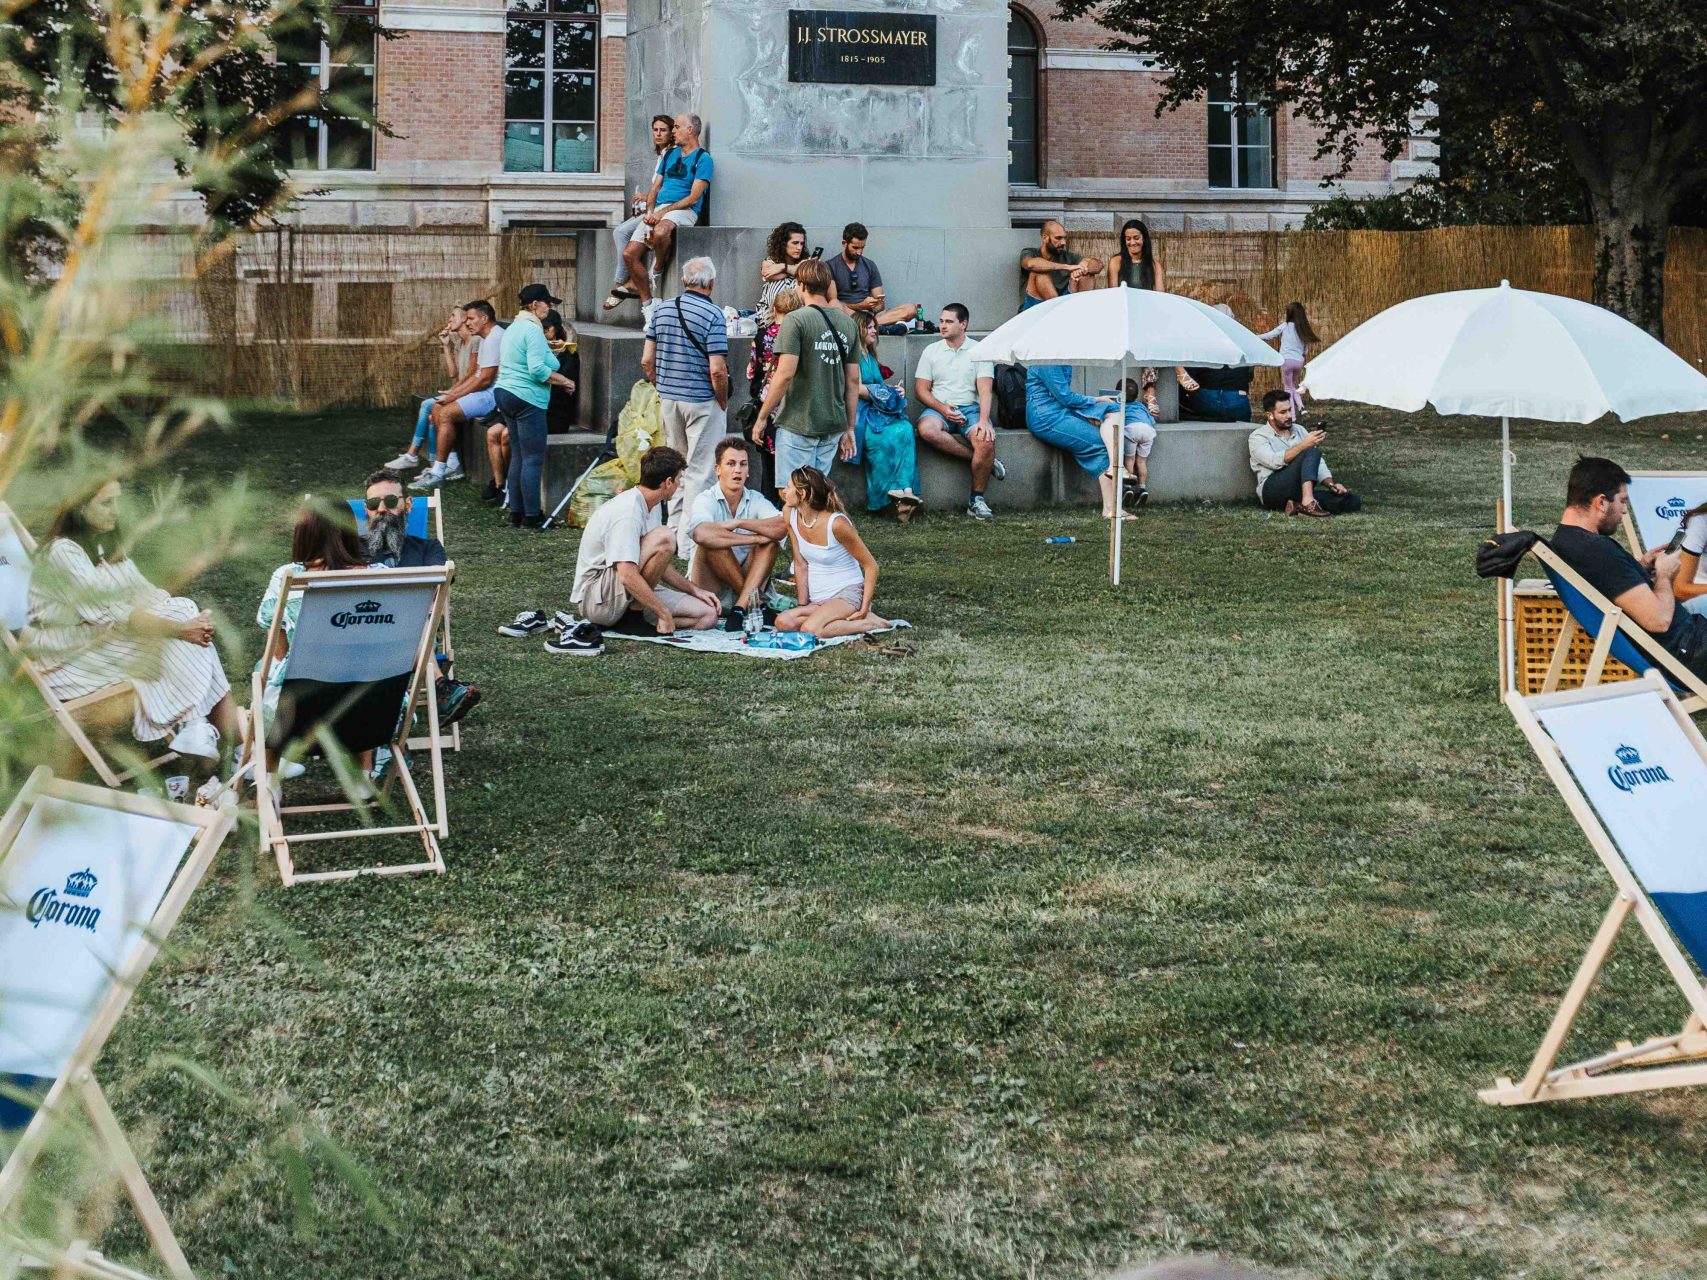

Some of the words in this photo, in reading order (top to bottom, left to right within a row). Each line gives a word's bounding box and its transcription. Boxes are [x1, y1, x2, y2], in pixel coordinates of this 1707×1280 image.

[817, 28, 928, 46] STROSSMAYER
[1655, 506, 1688, 520] Coro
[330, 611, 396, 629] Corona
[1608, 765, 1675, 794] Corona
[26, 887, 101, 933] Corona
